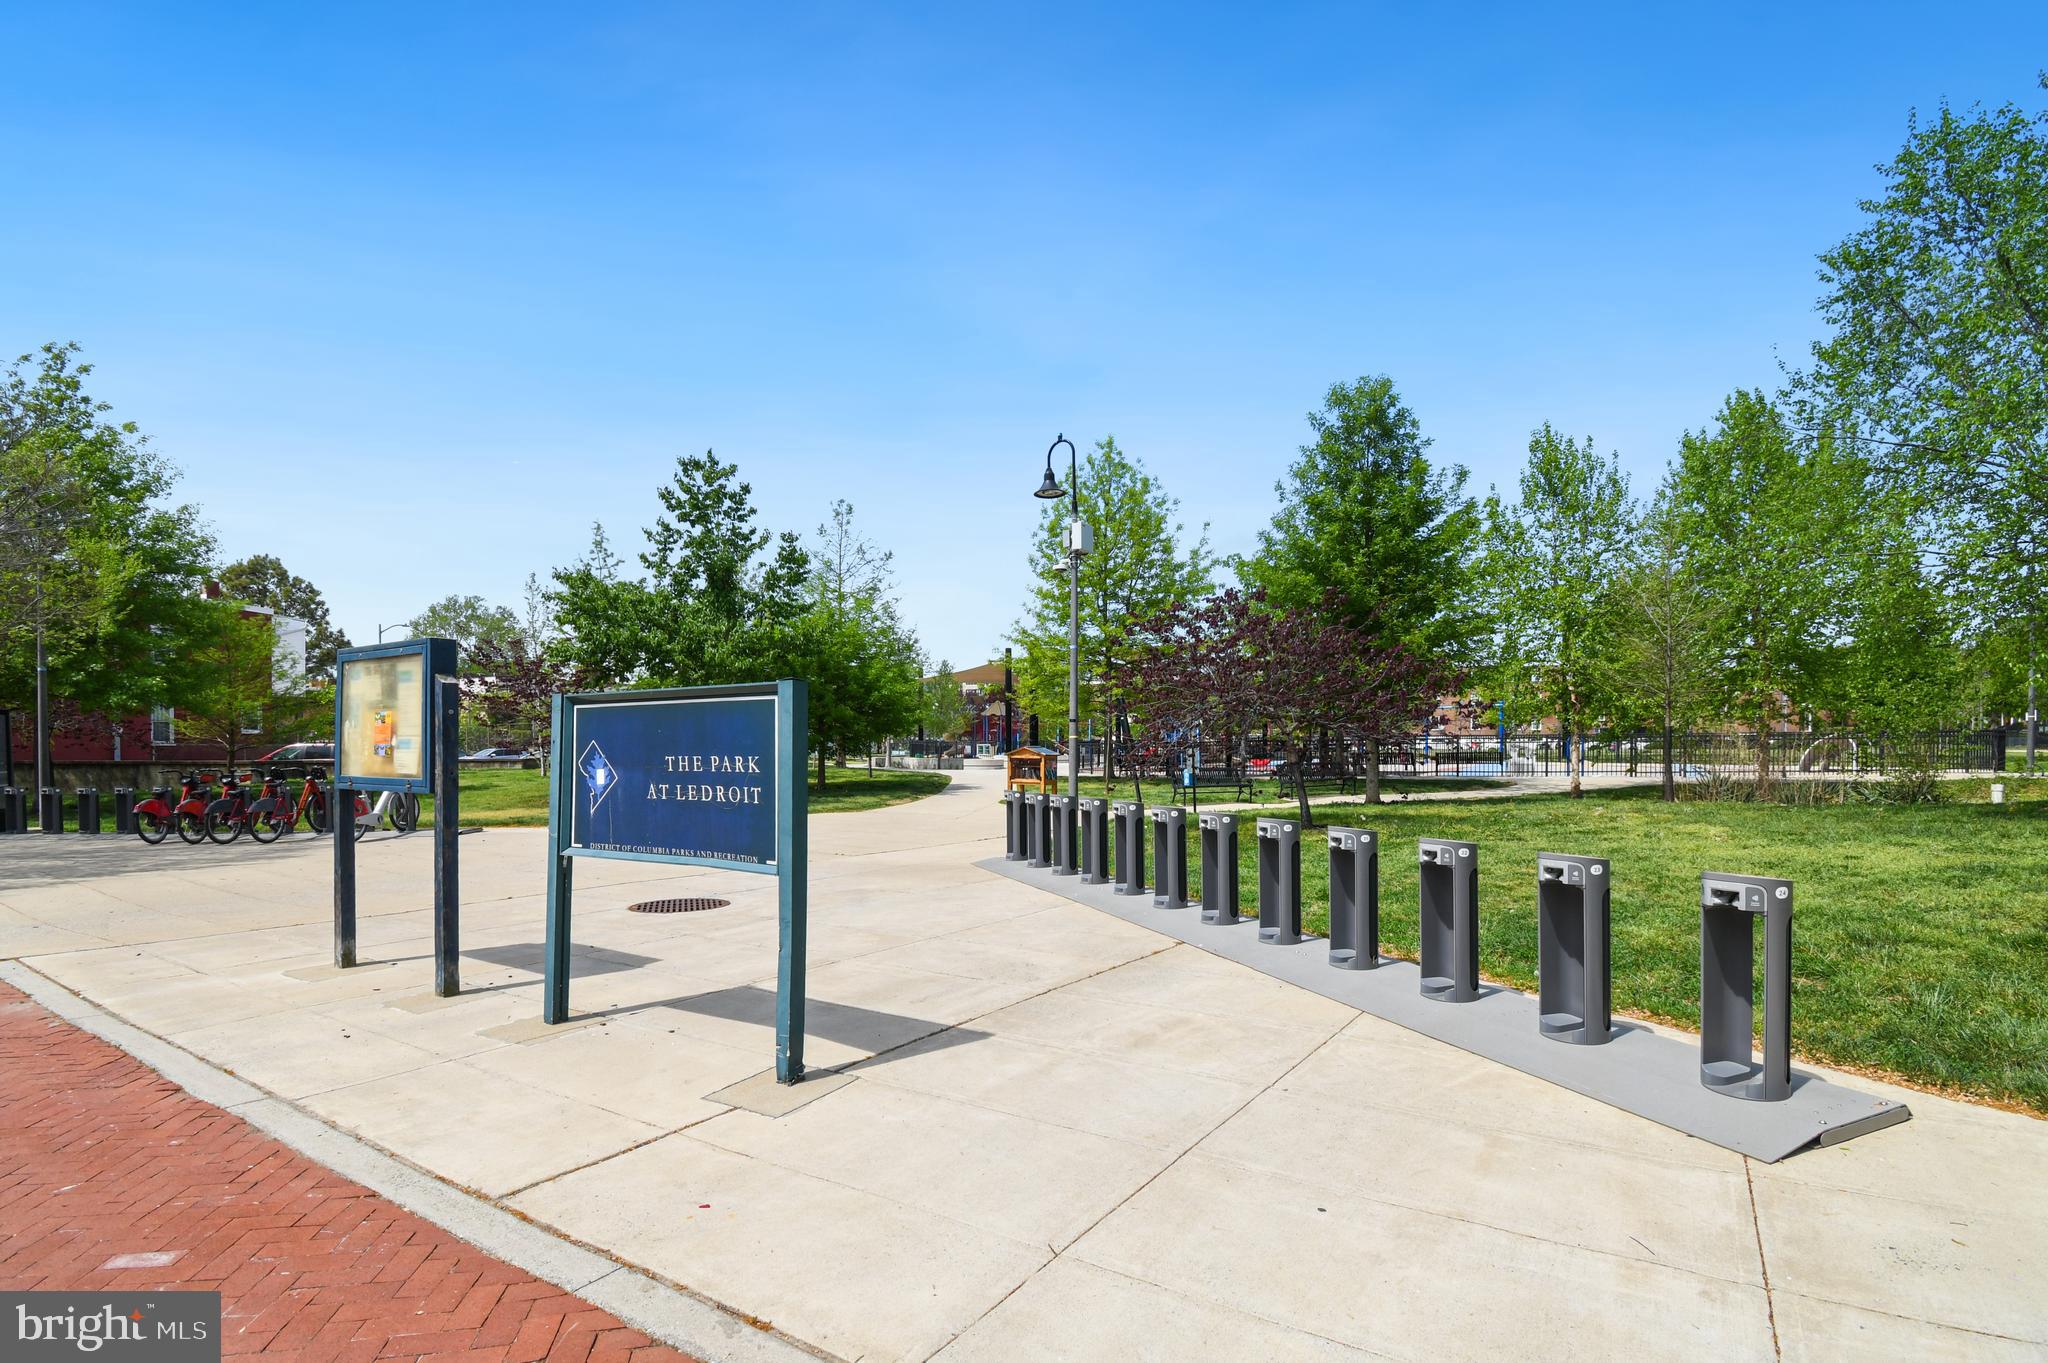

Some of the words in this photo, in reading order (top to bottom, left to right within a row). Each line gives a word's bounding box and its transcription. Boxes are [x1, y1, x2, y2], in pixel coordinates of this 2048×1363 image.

[665, 755, 703, 773] THE
[711, 755, 761, 773] PARK
[647, 783, 669, 800] AT
[676, 784, 762, 804] LEDROIT
[590, 842, 620, 852] DISTRICT
[622, 844, 631, 853] OF
[632, 845, 670, 855] COLUMBIA
[671, 848, 695, 857] PARKS
[697, 850, 712, 859] AND
[714, 851, 758, 864] RECREATION
